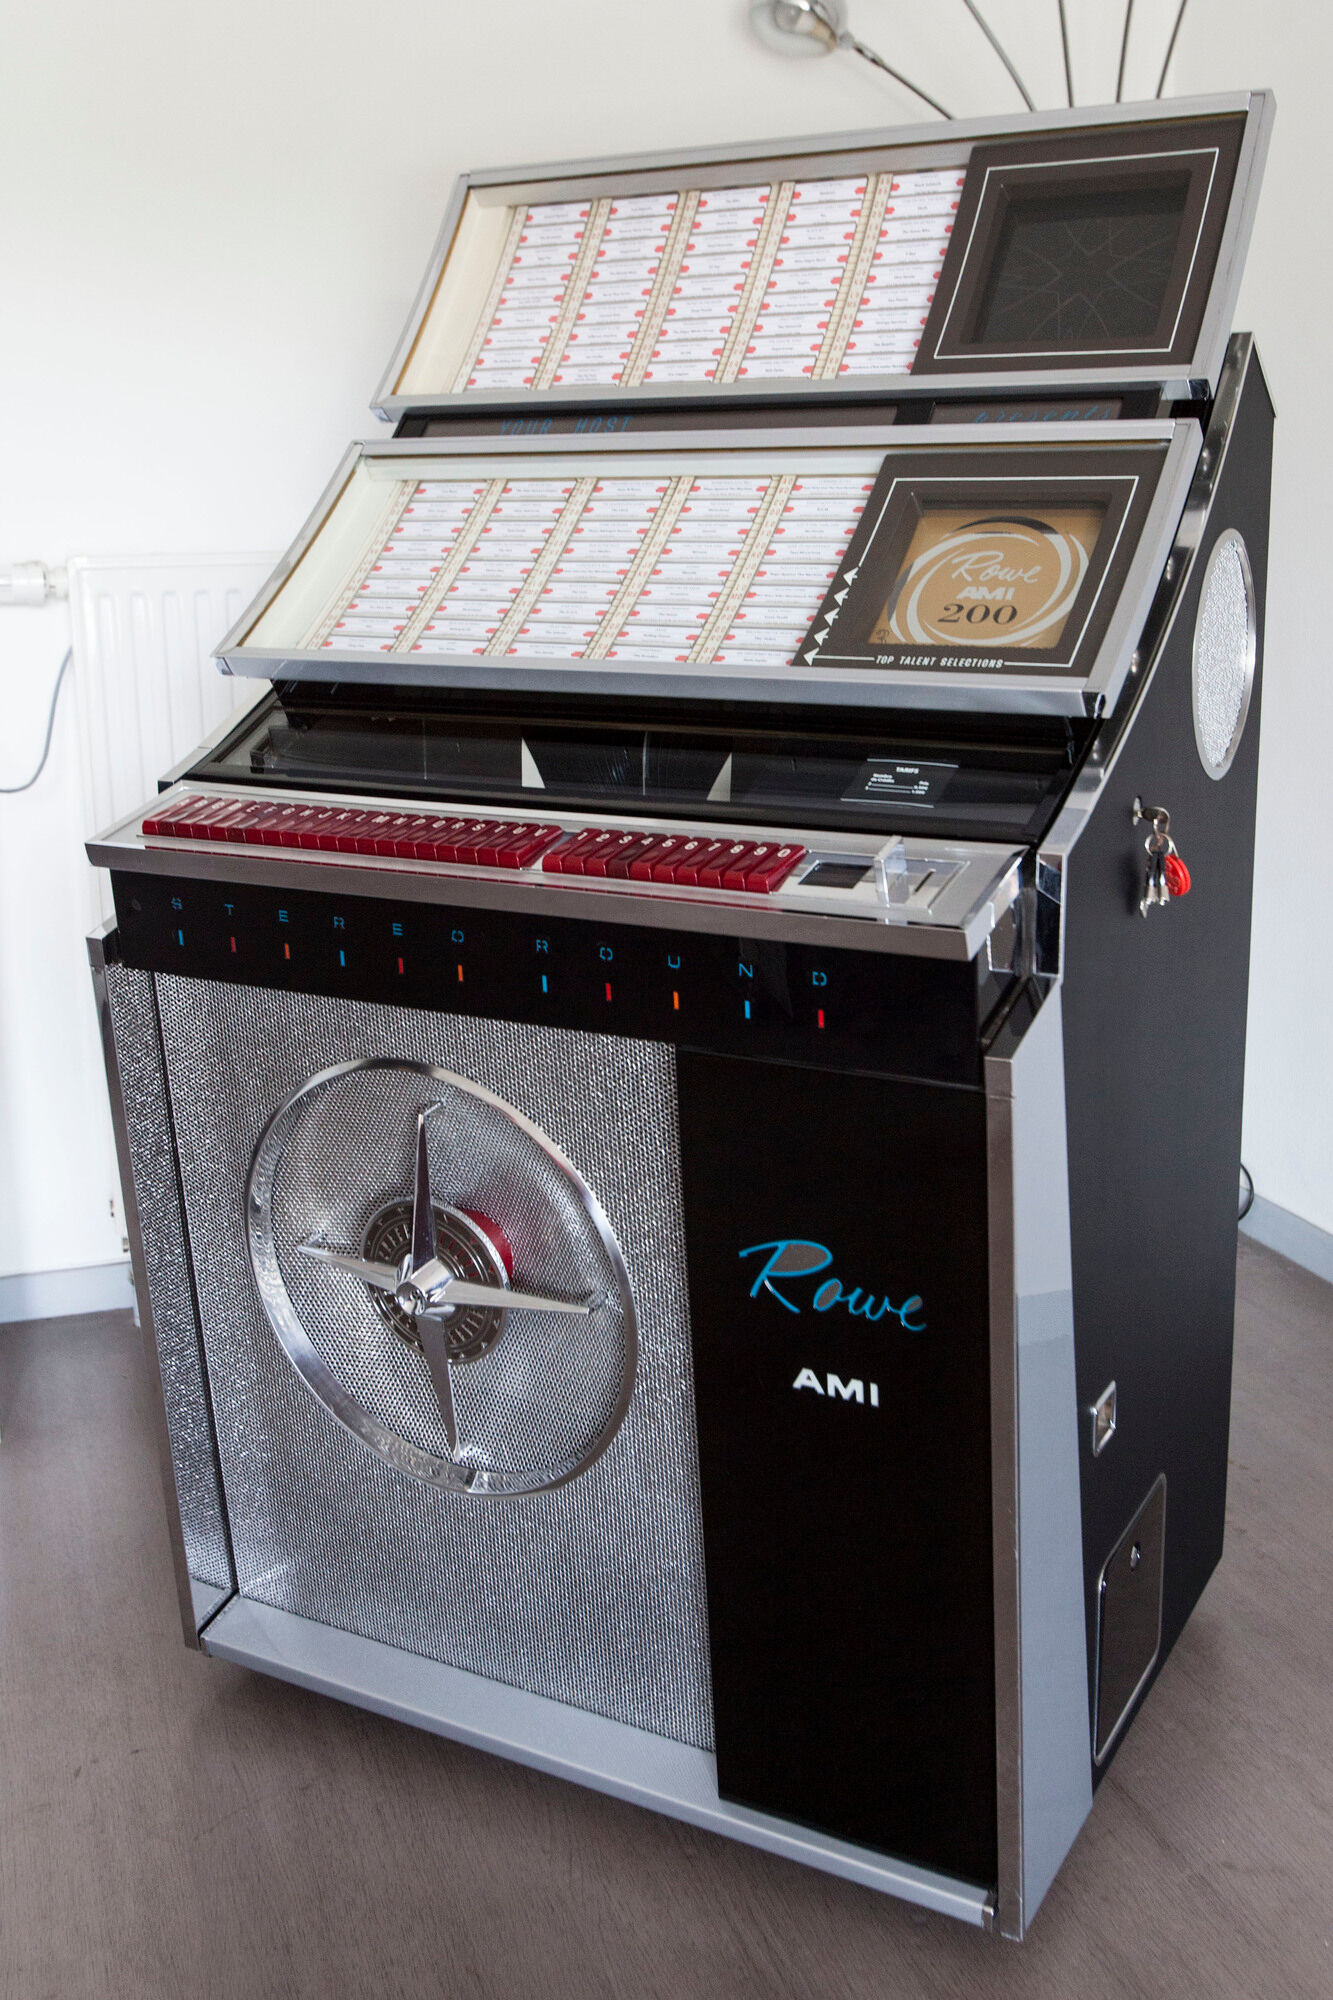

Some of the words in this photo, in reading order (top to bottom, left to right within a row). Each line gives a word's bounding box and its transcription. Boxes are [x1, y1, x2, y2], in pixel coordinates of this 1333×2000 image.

[500, 417, 552, 435] YOUR
[573, 415, 632, 434] HOST
[951, 551, 1042, 583] Rowe
[956, 586, 1016, 601] AMI
[937, 603, 1018, 625] 200
[876, 655, 895, 665] TOP
[899, 656, 936, 666] TALENT
[940, 656, 1004, 669] SELECTIONS
[318, 811, 333, 819] J
[336, 812, 352, 820] K
[371, 815, 390, 823] M
[412, 818, 426, 826] P
[471, 823, 486, 831] S
[494, 825, 507, 833] T
[513, 826, 527, 834] U
[534, 828, 548, 837] V
[577, 831, 588, 841] 1
[595, 833, 610, 842] 2
[618, 835, 633, 844] 3
[641, 837, 653, 845] 4
[662, 838, 676, 848] 5
[684, 841, 699, 850] 6
[707, 842, 721, 852] 7
[730, 844, 744, 854] 8
[753, 846, 768, 856] 9
[777, 848, 792, 858] 0
[739, 1239, 927, 1331] Rowe
[792, 1367, 879, 1408] AMI
